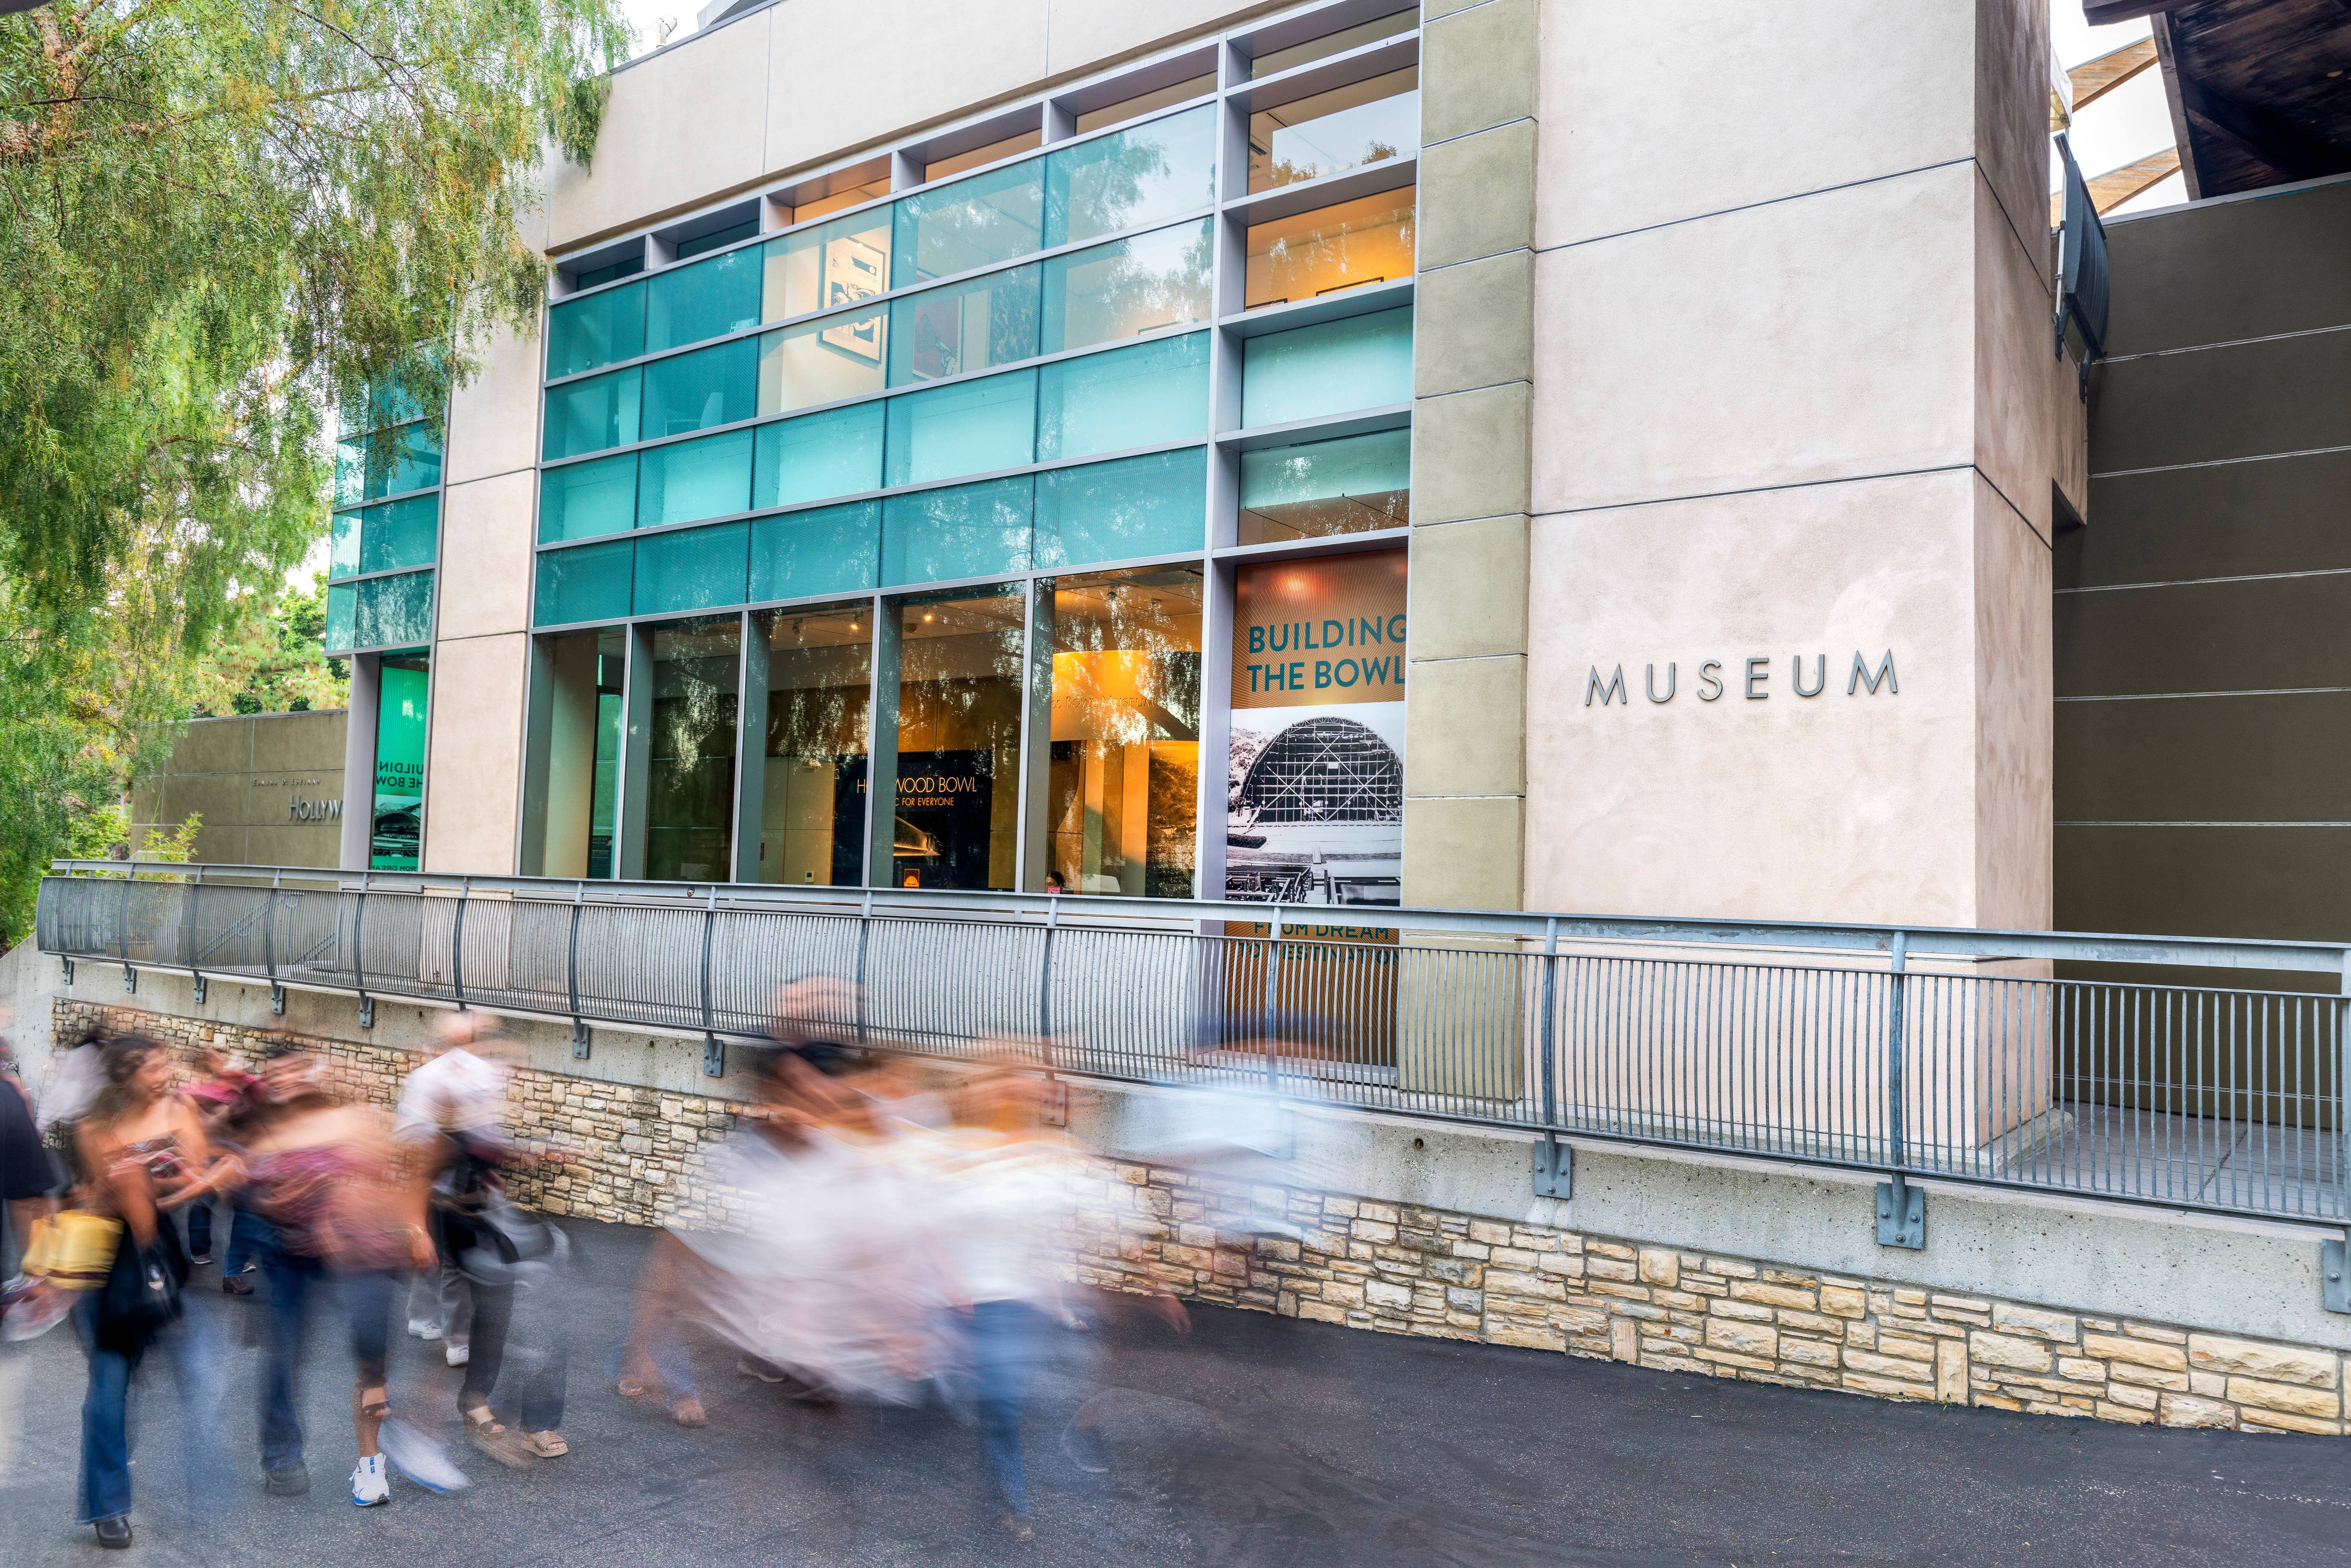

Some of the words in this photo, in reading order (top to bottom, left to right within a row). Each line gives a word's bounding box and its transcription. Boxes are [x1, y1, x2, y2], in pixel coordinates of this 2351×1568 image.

[1249, 614, 1407, 653] BUILDING
[1247, 662, 1305, 692] THE
[1315, 656, 1405, 688] BOWL
[1585, 648, 1898, 706] MUSEUM
[939, 777, 977, 792] BOWL
[289, 795, 343, 819] HOLLYW
[902, 798, 915, 806] FOR
[918, 797, 955, 806] EVERYONE
[1255, 922, 1308, 936] FOM
[1316, 925, 1388, 939] DREAM
